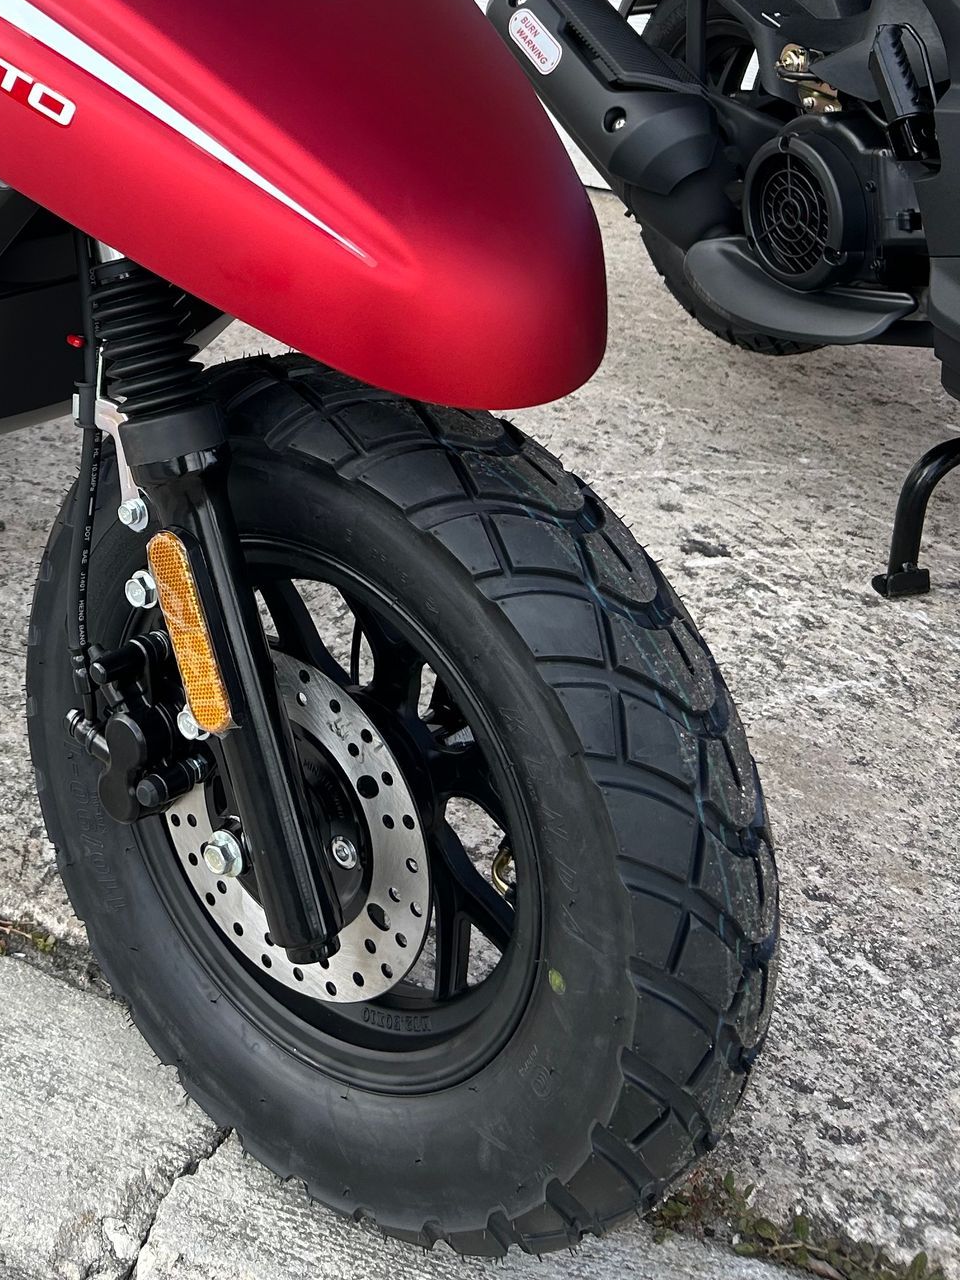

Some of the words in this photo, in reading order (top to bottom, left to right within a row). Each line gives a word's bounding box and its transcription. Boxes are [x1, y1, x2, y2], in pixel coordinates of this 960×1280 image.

[520, 16, 540, 38] BURN
[516, 27, 548, 65] WARNING
[84, 525, 92, 542] DOT
[81, 549, 89, 565] SAE
